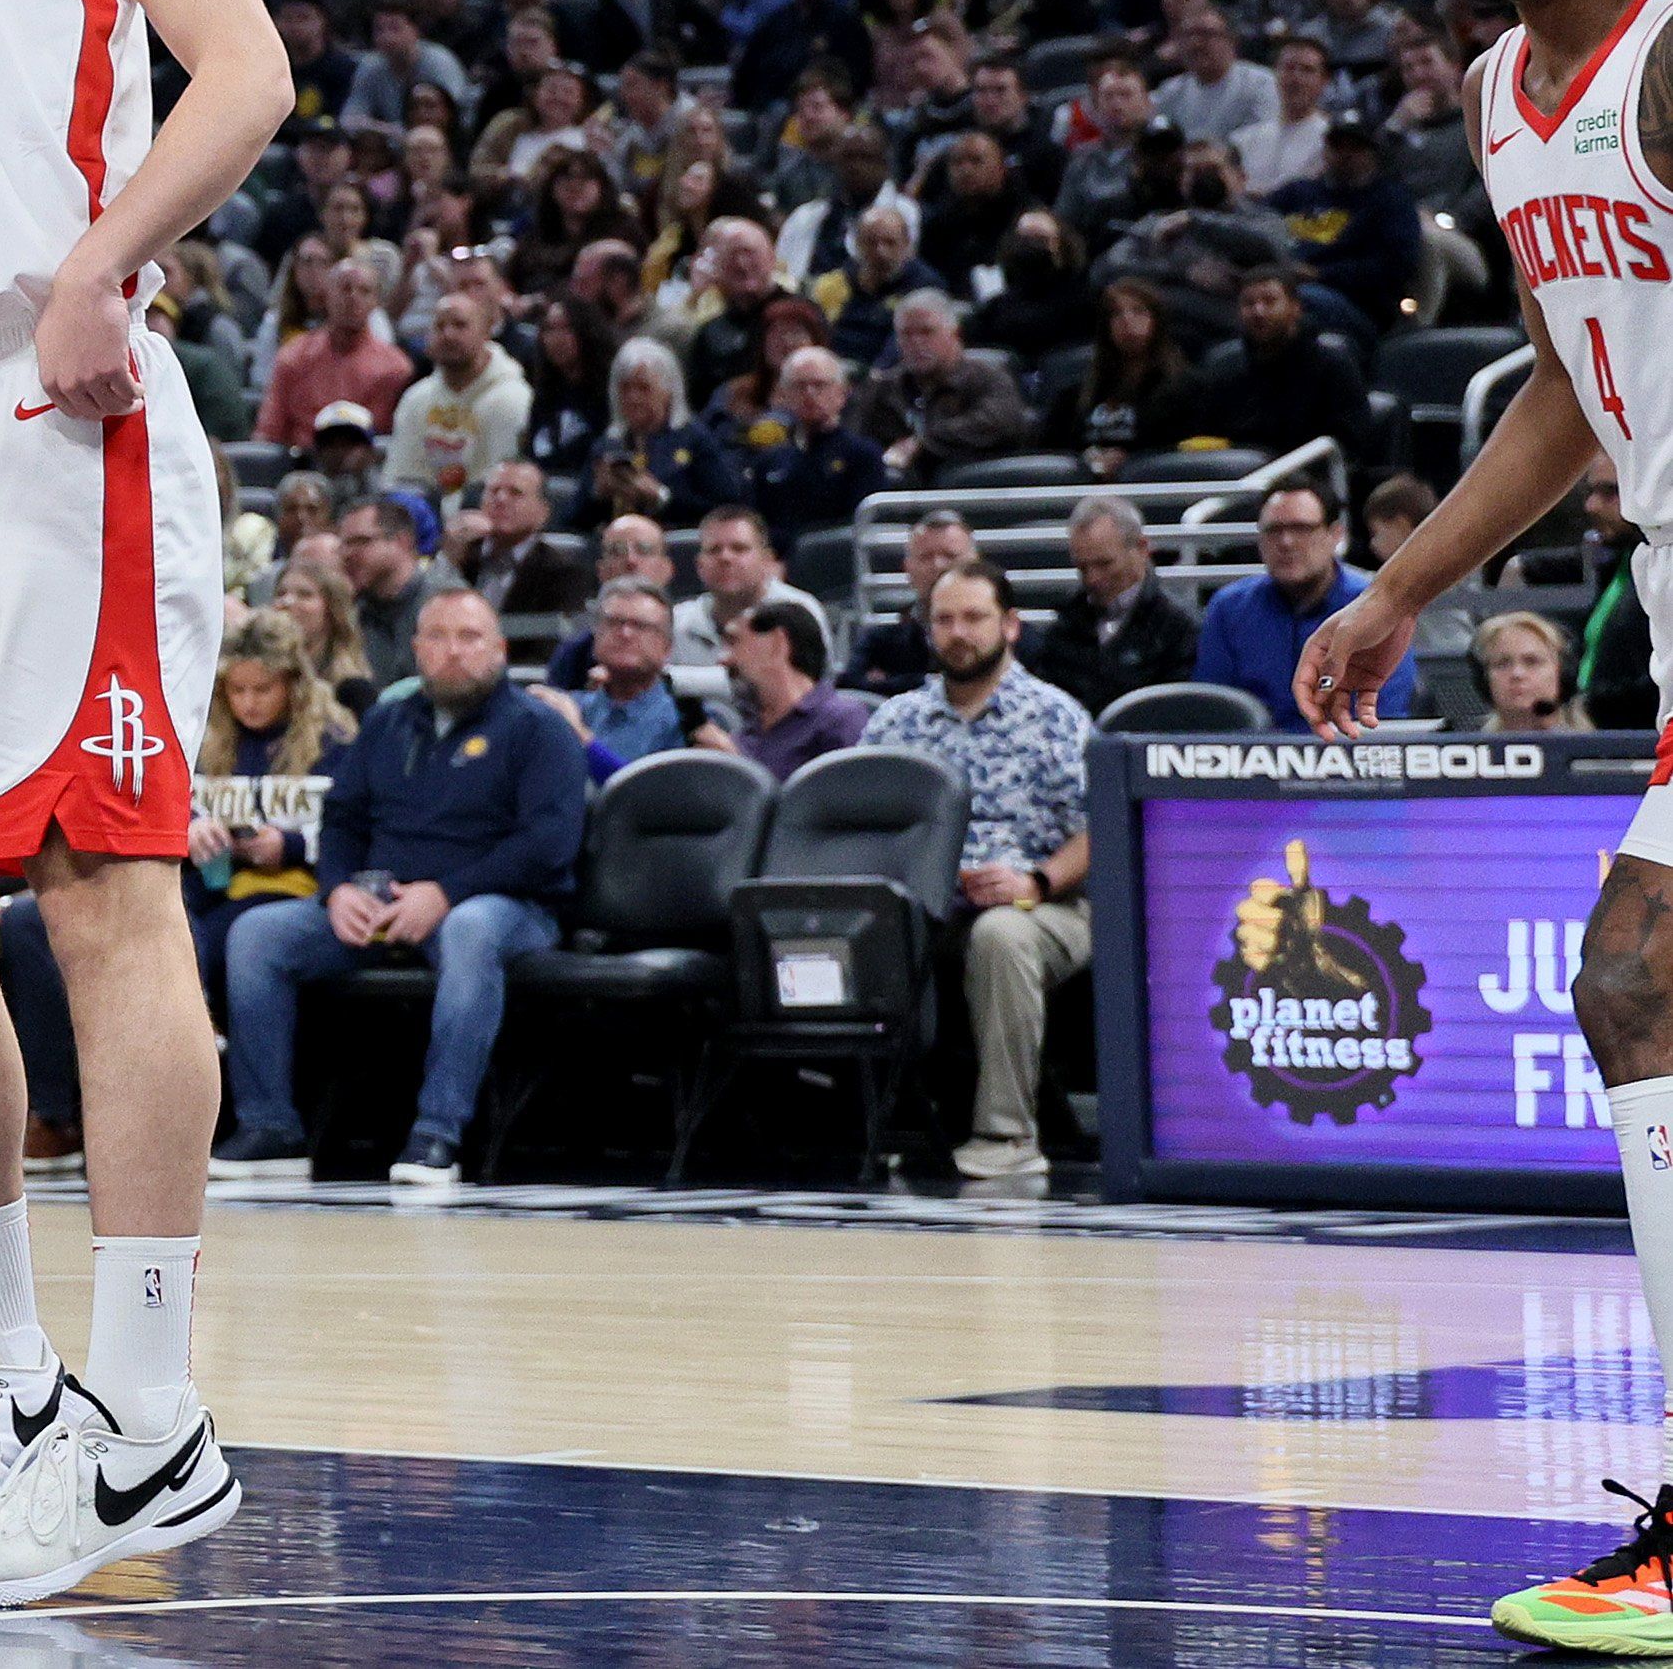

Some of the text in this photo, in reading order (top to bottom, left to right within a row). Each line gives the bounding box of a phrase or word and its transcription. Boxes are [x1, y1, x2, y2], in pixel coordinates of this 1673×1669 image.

[1575, 107, 1619, 134] credit
[1573, 130, 1620, 156] karma
[1500, 192, 1672, 291] OCKETS
[1583, 317, 1633, 442] 4
[1146, 744, 1352, 779] INDIANA
[1405, 744, 1545, 779] BOLD
[1229, 987, 1379, 1041] planet
[1251, 1028, 1414, 1071] fitness
